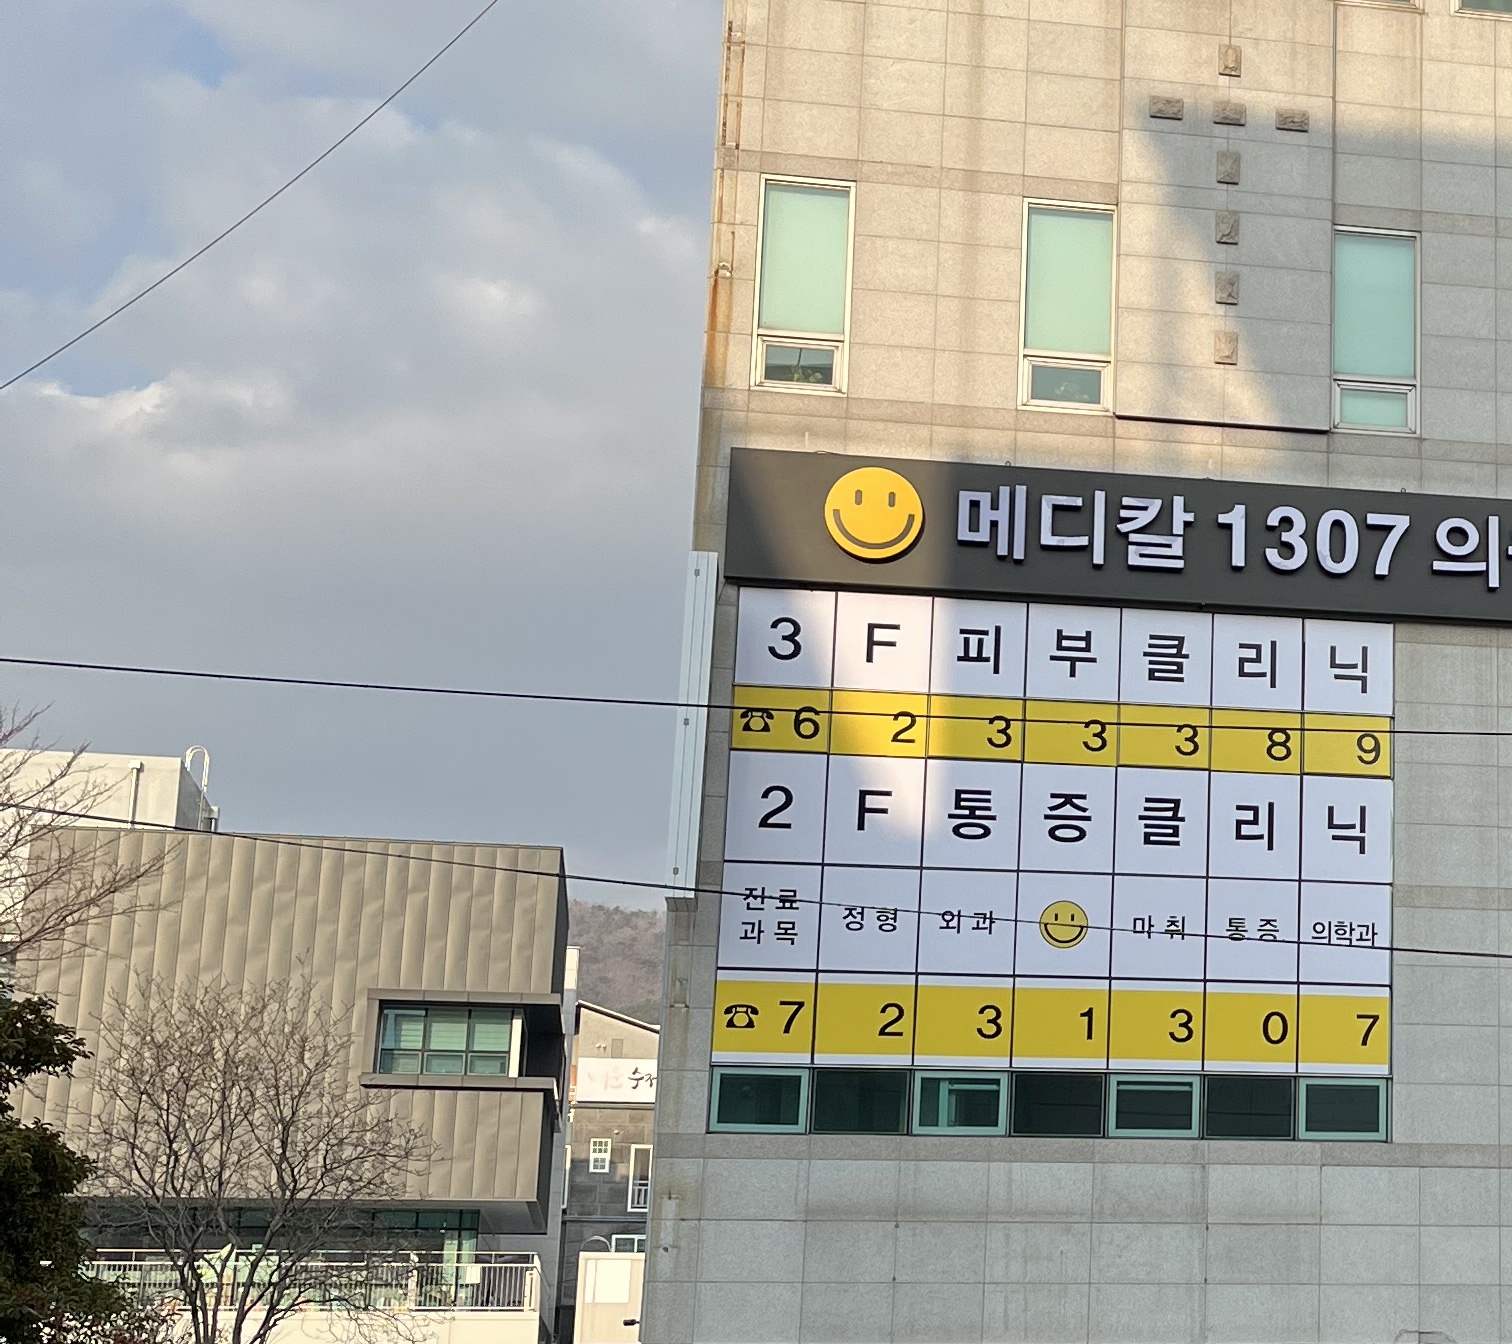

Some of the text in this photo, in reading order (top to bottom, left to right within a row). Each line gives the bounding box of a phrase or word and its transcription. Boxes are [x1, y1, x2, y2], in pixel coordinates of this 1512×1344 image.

[957, 484, 1195, 572] 메디칼
[1217, 503, 1411, 579] 1307
[956, 624, 1369, 695] 피부클리닉
[947, 788, 1368, 855] 통증클리닉
[742, 886, 800, 912] 진료
[739, 919, 799, 946] 과목
[1310, 920, 1379, 948] 의학과
